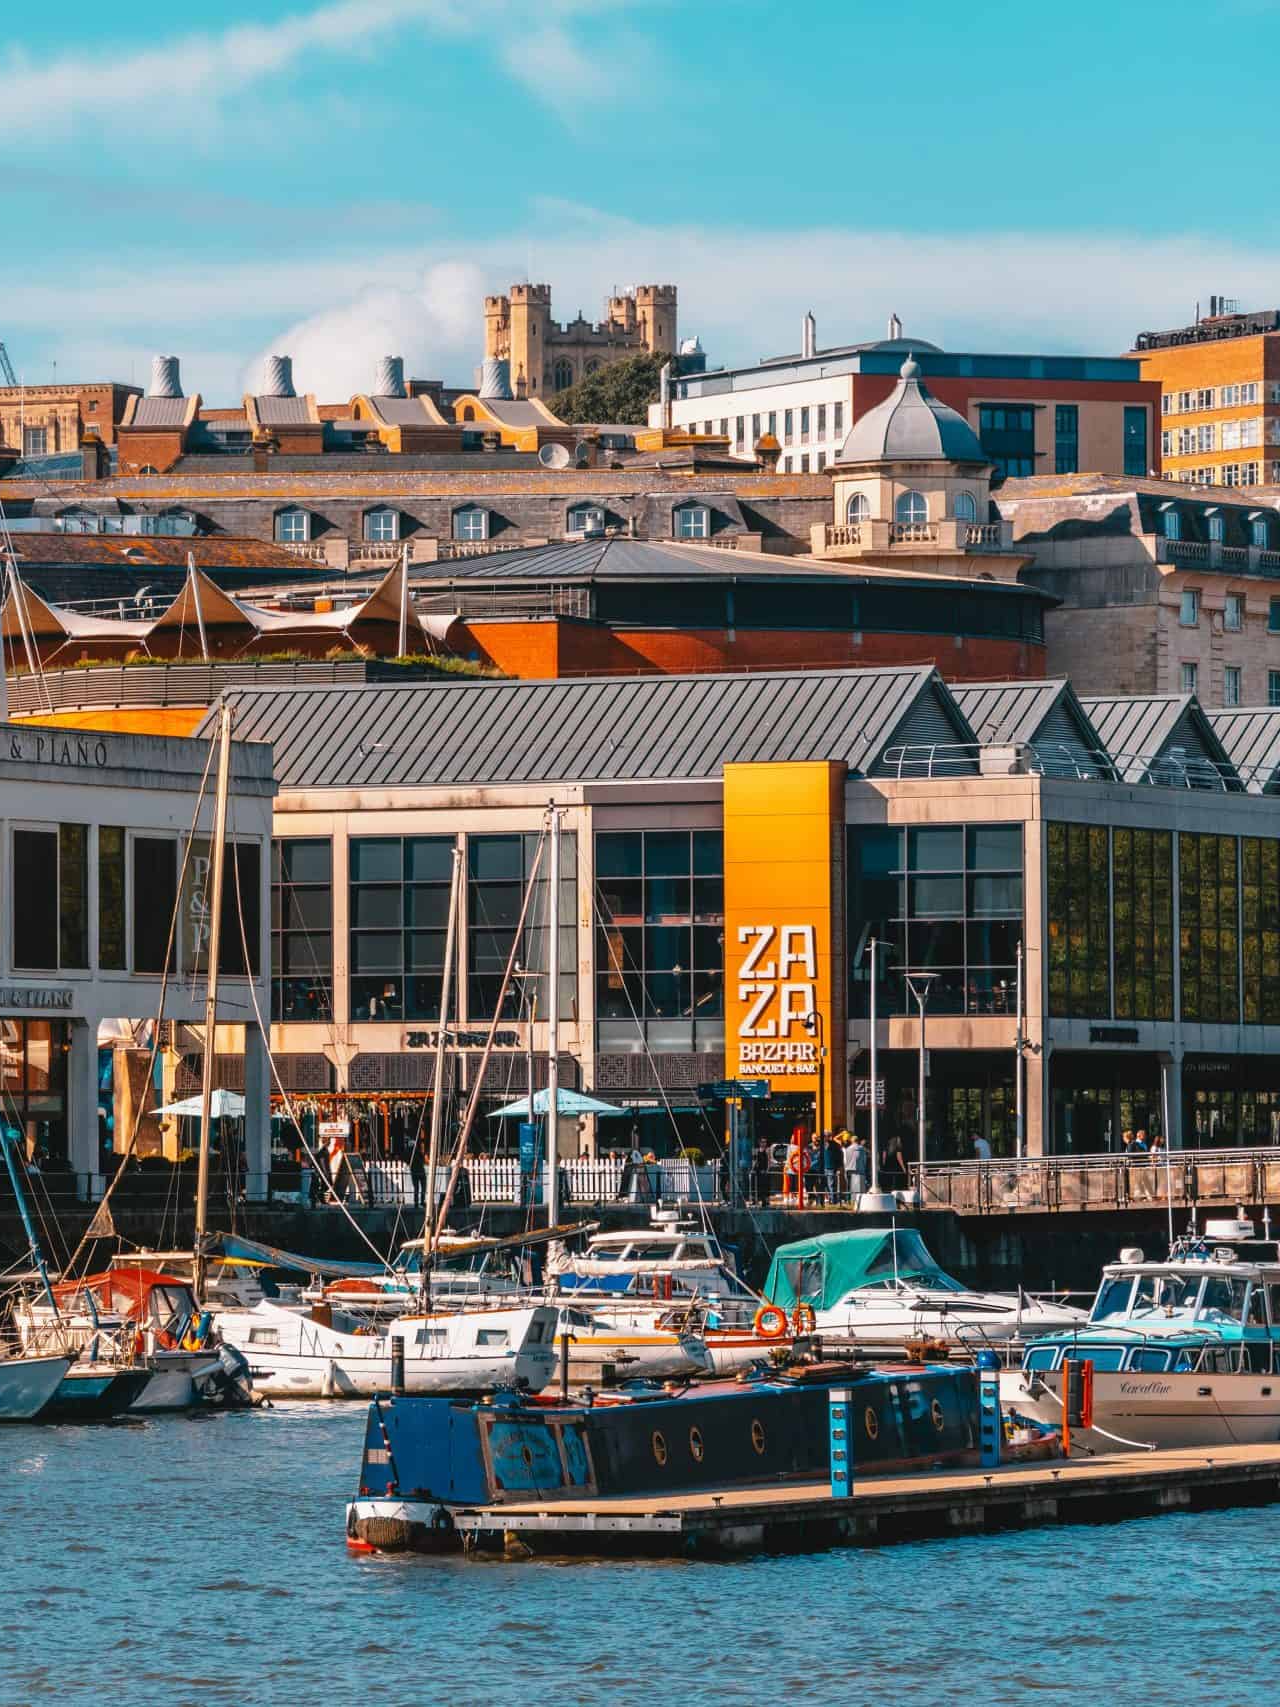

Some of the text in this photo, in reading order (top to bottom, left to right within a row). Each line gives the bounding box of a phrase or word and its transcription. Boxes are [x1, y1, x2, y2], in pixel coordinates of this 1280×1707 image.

[10, 735, 24, 760] &
[36, 737, 108, 767] PIANO
[737, 925, 816, 979] ZA
[737, 983, 817, 1037] ZA
[738, 1041, 817, 1062] BAZAAR
[738, 1063, 786, 1075] BANQUET
[796, 1063, 817, 1074] BAR
